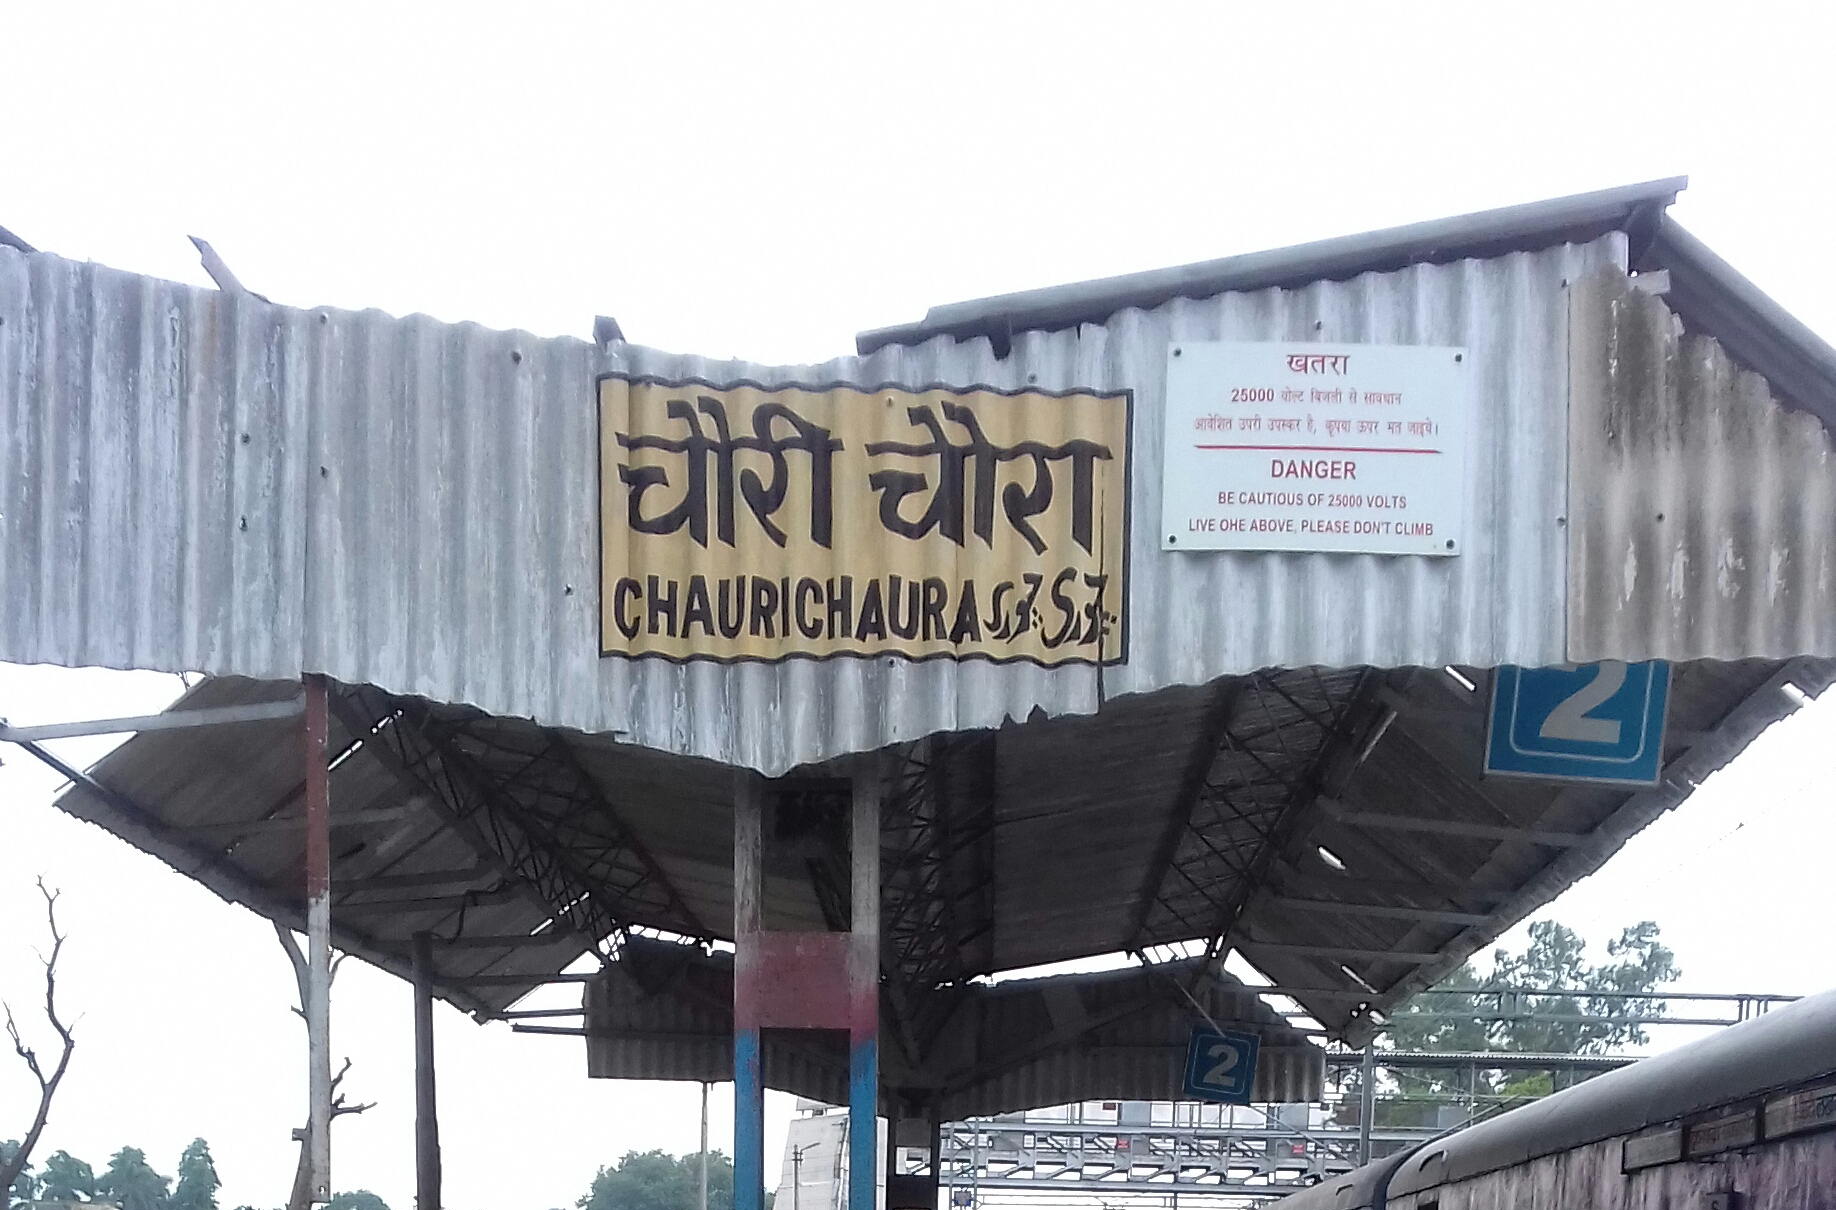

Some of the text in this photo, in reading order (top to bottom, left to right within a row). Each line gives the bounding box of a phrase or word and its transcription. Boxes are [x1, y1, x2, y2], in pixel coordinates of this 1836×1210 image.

[1286, 354, 1350, 375] खतरा
[1231, 388, 1275, 403] 25000
[615, 396, 1113, 556] चौरी चौरा
[1271, 459, 1356, 480] DANGER
[1218, 491, 1407, 509] BE CAUTIOUS OF 25000 VOLTS
[1189, 518, 1216, 532] LIVE
[1219, 519, 1246, 532] OHE
[1301, 520, 1350, 534] PLEASE
[1354, 520, 1391, 535] DON'T
[1395, 522, 1434, 536] CLIMB
[1203, 1044, 1239, 1087] 2
